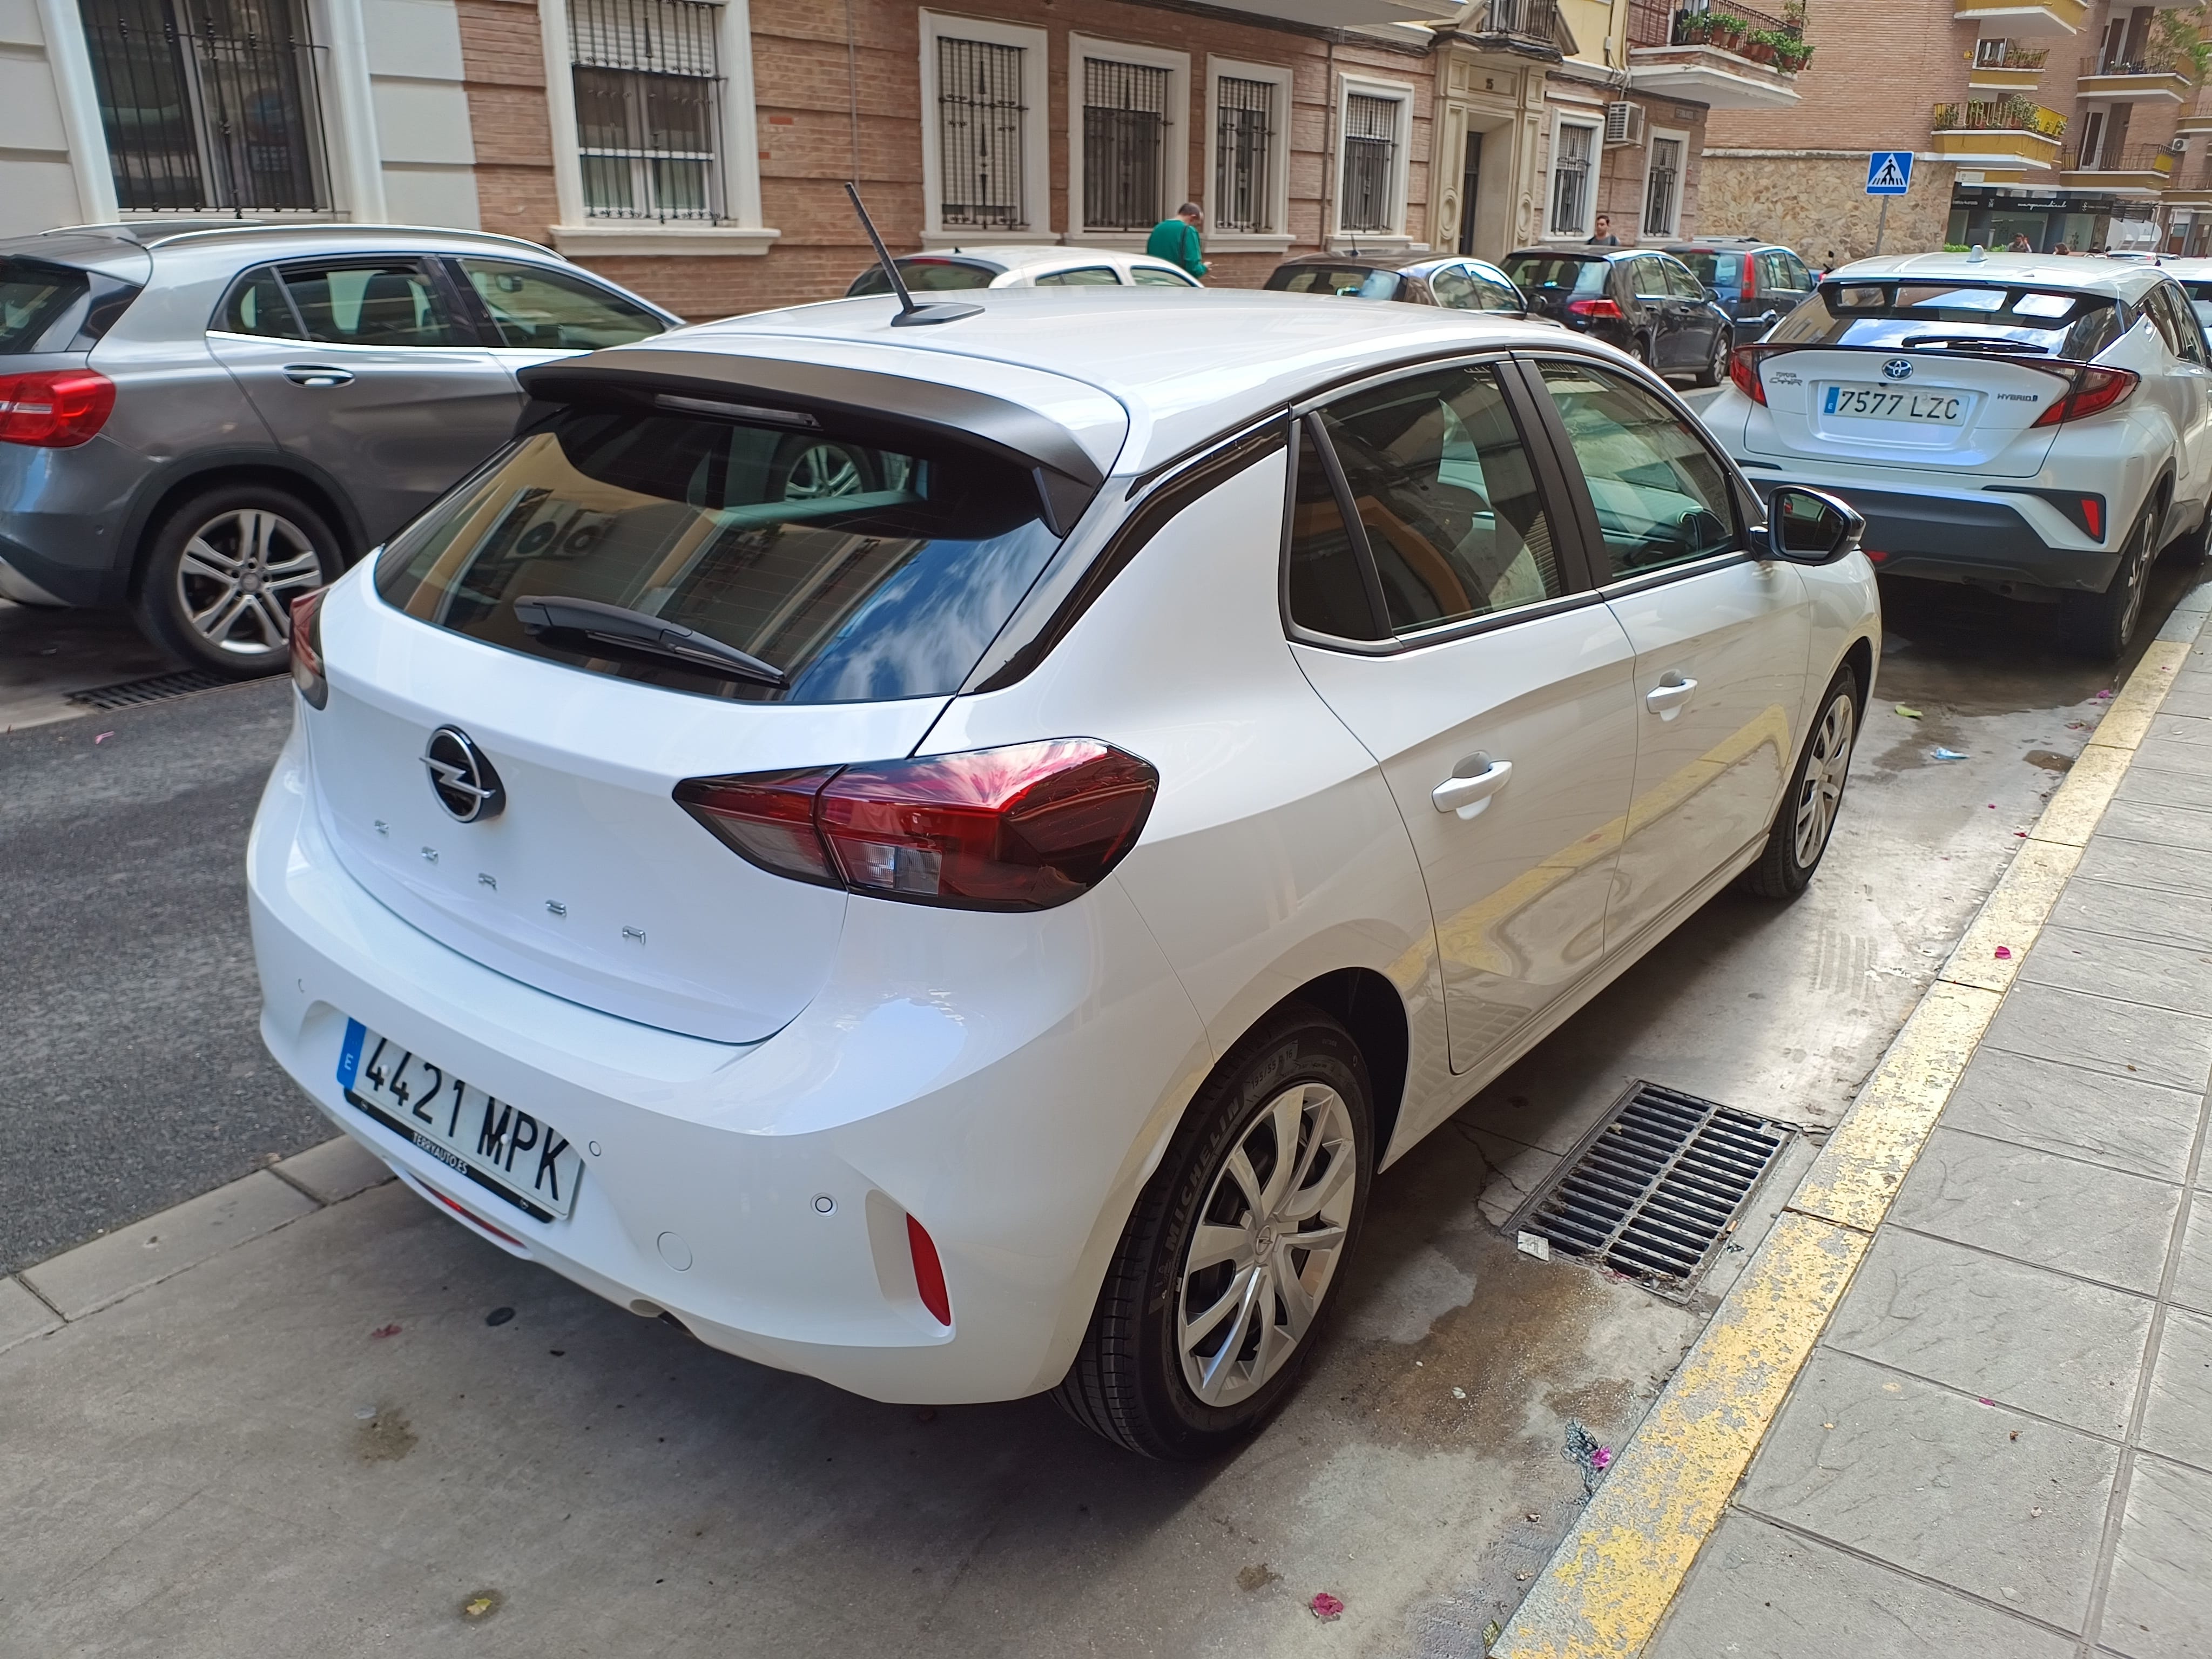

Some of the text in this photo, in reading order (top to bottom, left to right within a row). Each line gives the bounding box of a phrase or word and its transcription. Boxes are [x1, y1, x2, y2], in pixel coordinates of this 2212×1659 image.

[1839, 390, 1960, 420] 7577 LZC
[1997, 393, 2032, 402] HYBRID
[344, 1053, 354, 1071] E
[366, 1037, 569, 1202] 4421 MPK
[1165, 1096, 1240, 1252] MICHELIN
